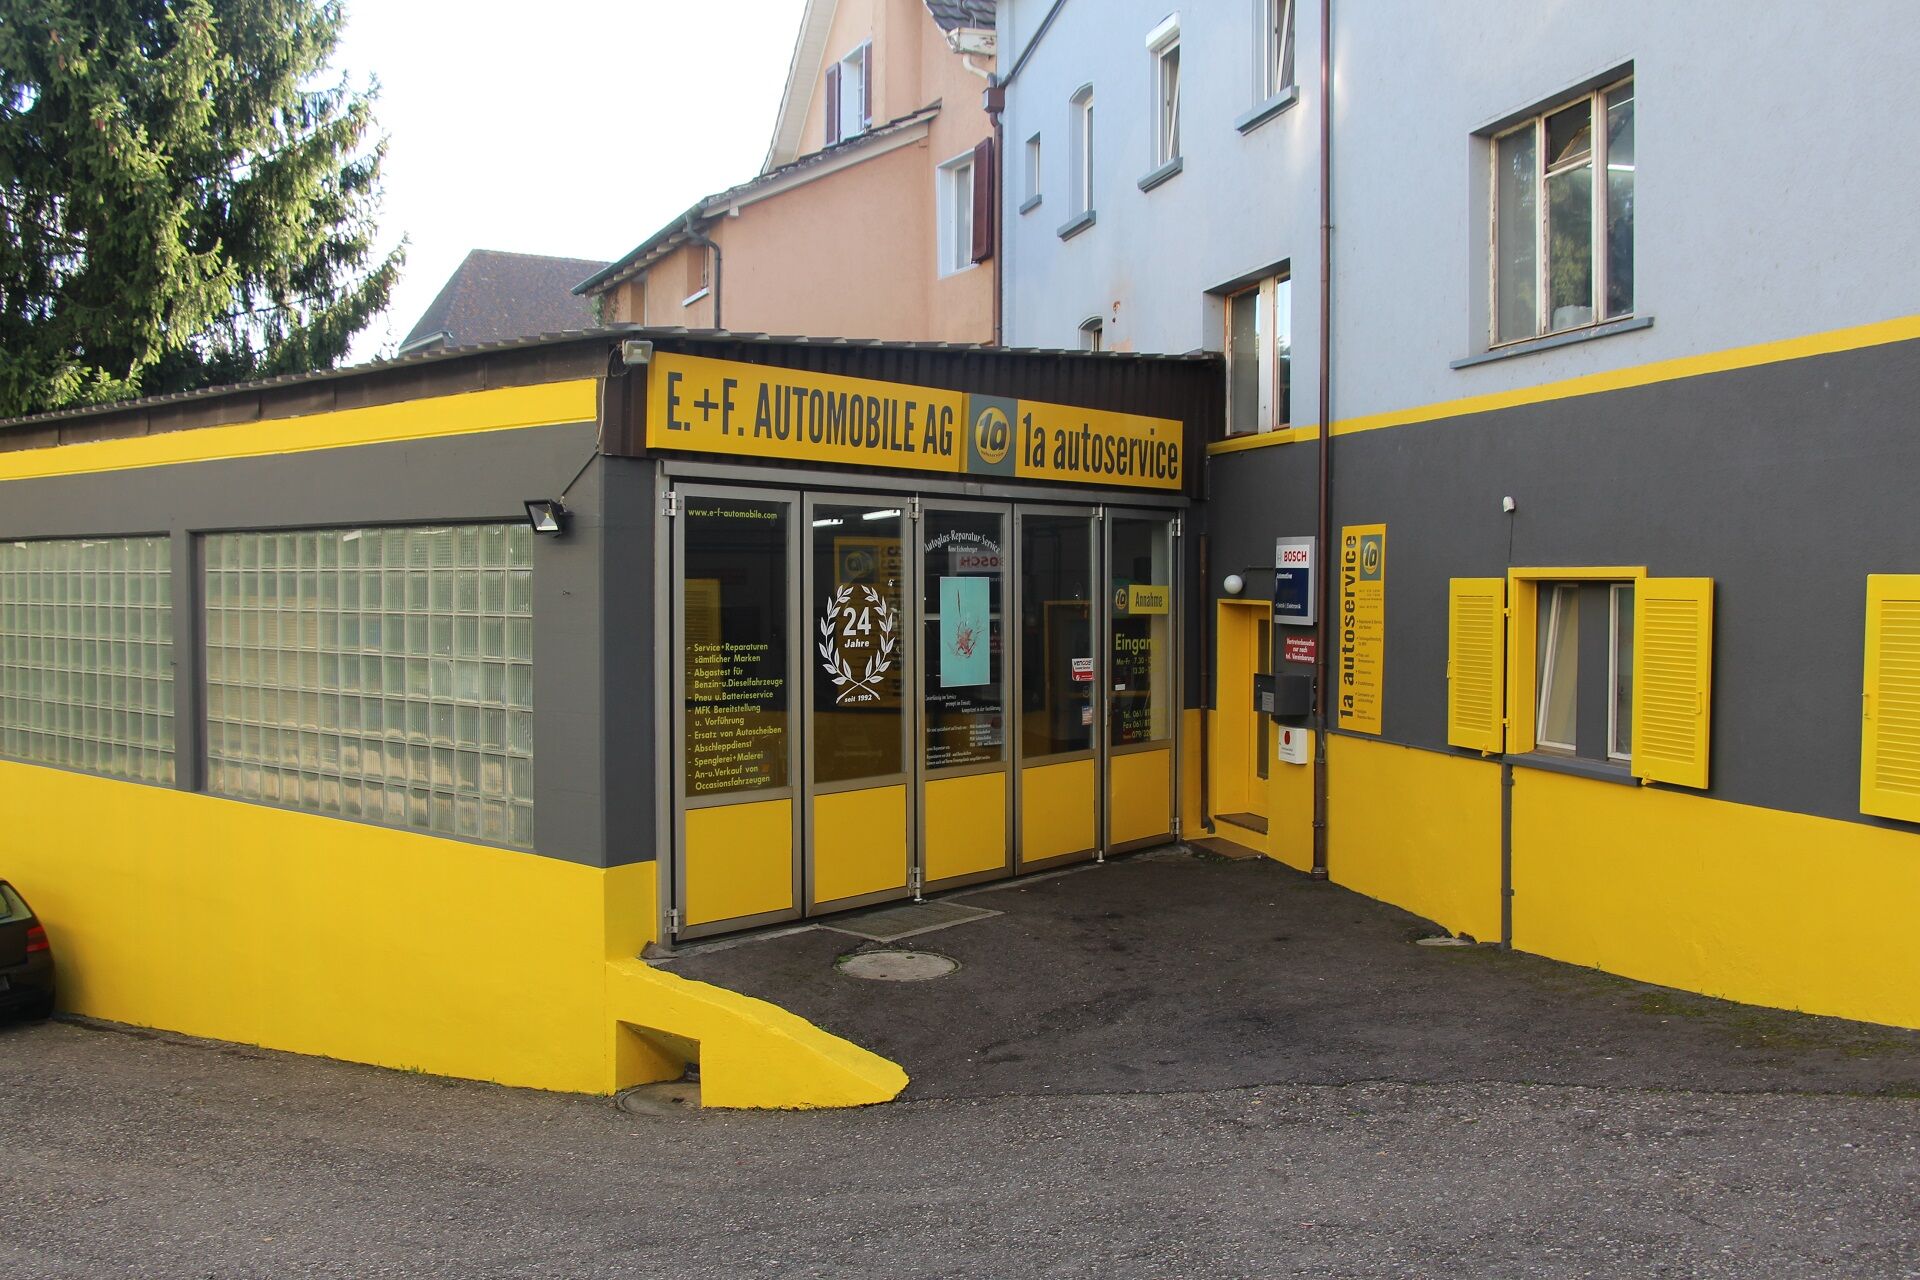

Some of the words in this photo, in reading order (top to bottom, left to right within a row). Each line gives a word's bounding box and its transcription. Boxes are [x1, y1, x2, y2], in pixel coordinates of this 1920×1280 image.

[754, 382, 917, 452] AUTOMOBILE
[922, 403, 953, 456] AG
[1022, 412, 1046, 468] 1a
[1053, 423, 1178, 480] autoservice
[688, 508, 777, 519] www.e-f-automobile.com
[1284, 551, 1307, 562] BOSCH
[1135, 592, 1163, 607] Annahme
[1342, 535, 1357, 686] autoservice
[843, 607, 872, 636] 24
[844, 639, 870, 648] Jahre
[694, 654, 731, 664] sämtlicher
[733, 653, 761, 662] Marken
[694, 668, 731, 678] Abgastest
[733, 667, 743, 675] für
[694, 694, 712, 702] Pneu
[857, 694, 872, 702] 1992
[694, 705, 711, 715] MFK
[713, 703, 761, 714] Bereitstellung
[1340, 694, 1354, 718] 1a
[704, 716, 745, 726] Vorführung
[694, 730, 717, 740] Ersatz
[736, 725, 782, 736] Autoscheiben
[694, 740, 752, 753] Abschleppdienst
[745, 766, 758, 774] von
[695, 776, 770, 791] Occasionsfahrzeugen
